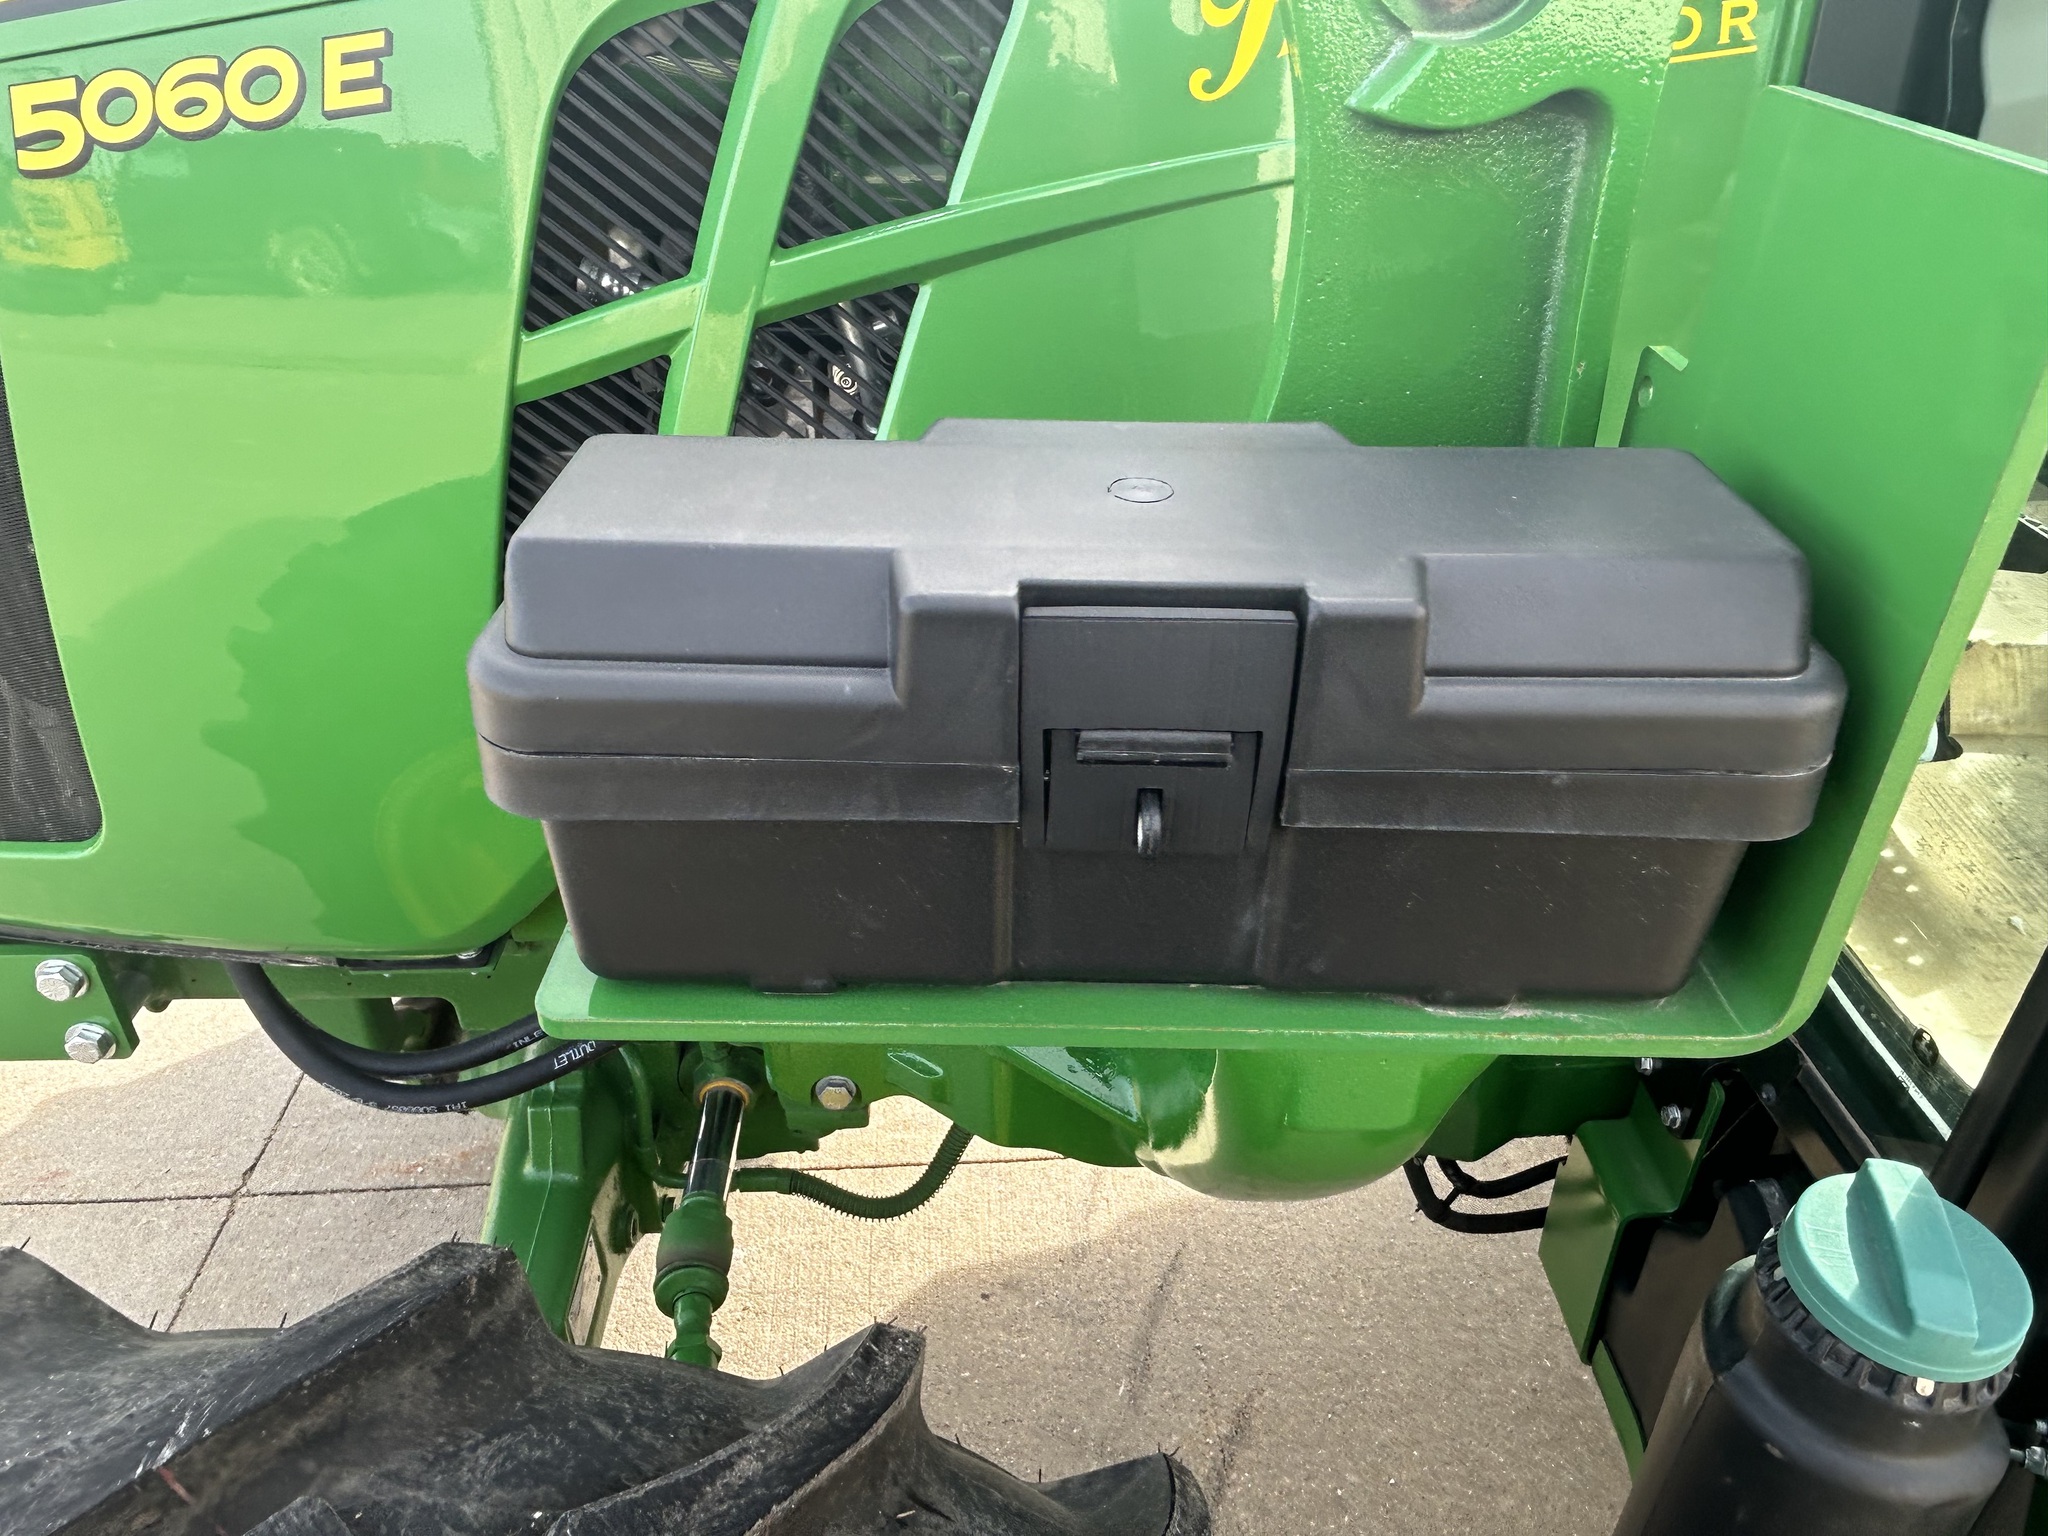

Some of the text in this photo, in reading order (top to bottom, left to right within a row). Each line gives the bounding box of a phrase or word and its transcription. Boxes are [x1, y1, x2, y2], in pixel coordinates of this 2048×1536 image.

[8, 27, 394, 180] 5060 E
[553, 1040, 597, 1070] OUTLET
